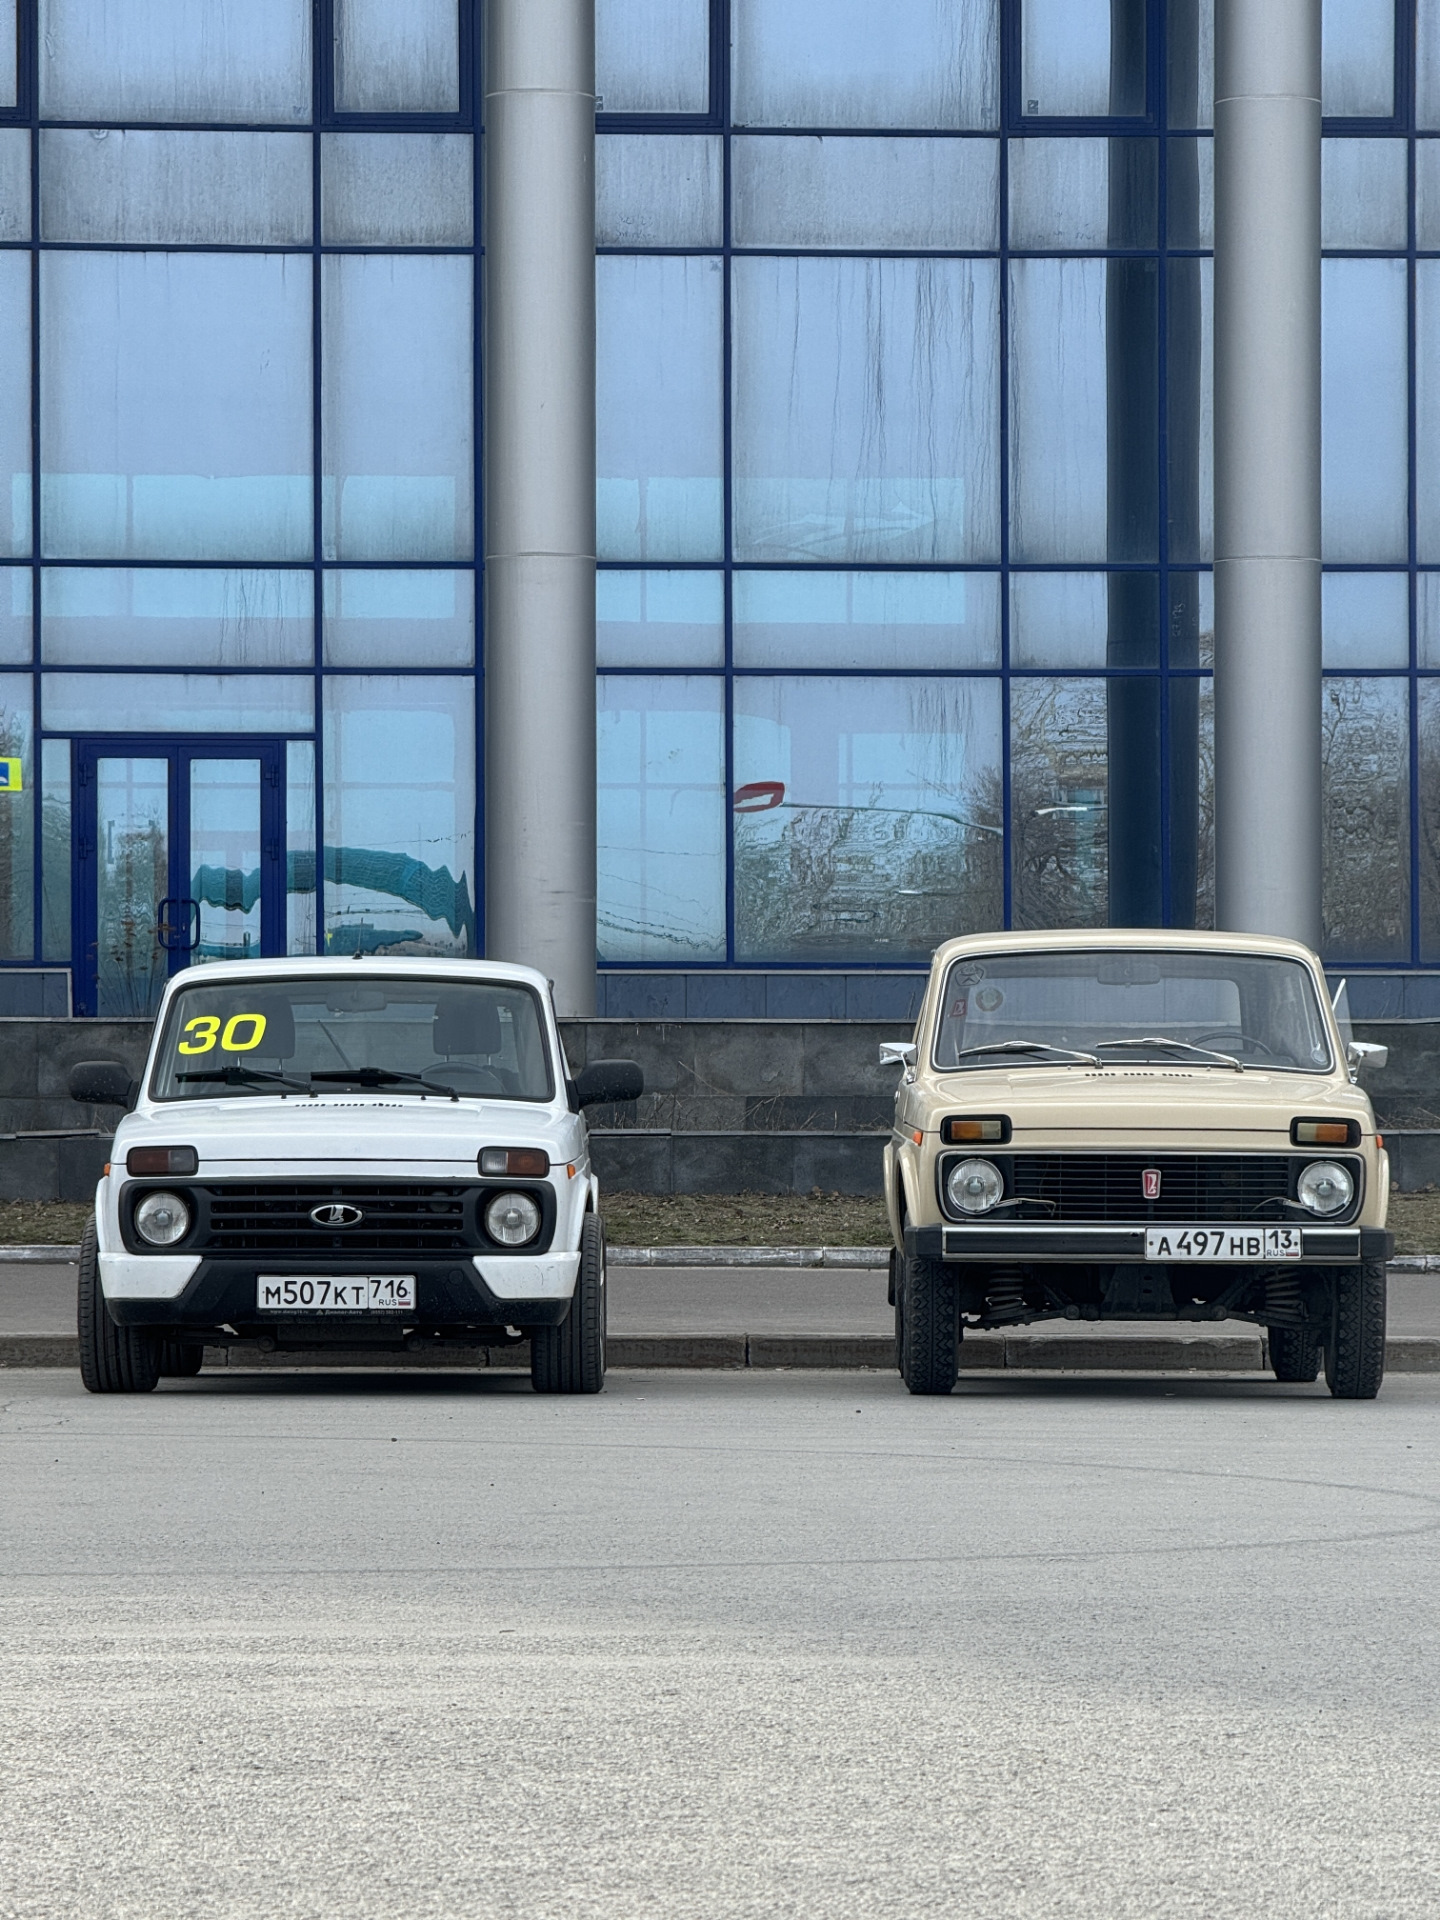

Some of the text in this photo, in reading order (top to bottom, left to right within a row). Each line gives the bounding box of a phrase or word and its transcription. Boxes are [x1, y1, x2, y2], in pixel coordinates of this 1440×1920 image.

[178, 1013, 267, 1055] 30
[1268, 1230, 1293, 1249] 13
[1266, 1249, 1285, 1257] RUS
[265, 1280, 408, 1305] М507КТ 716
